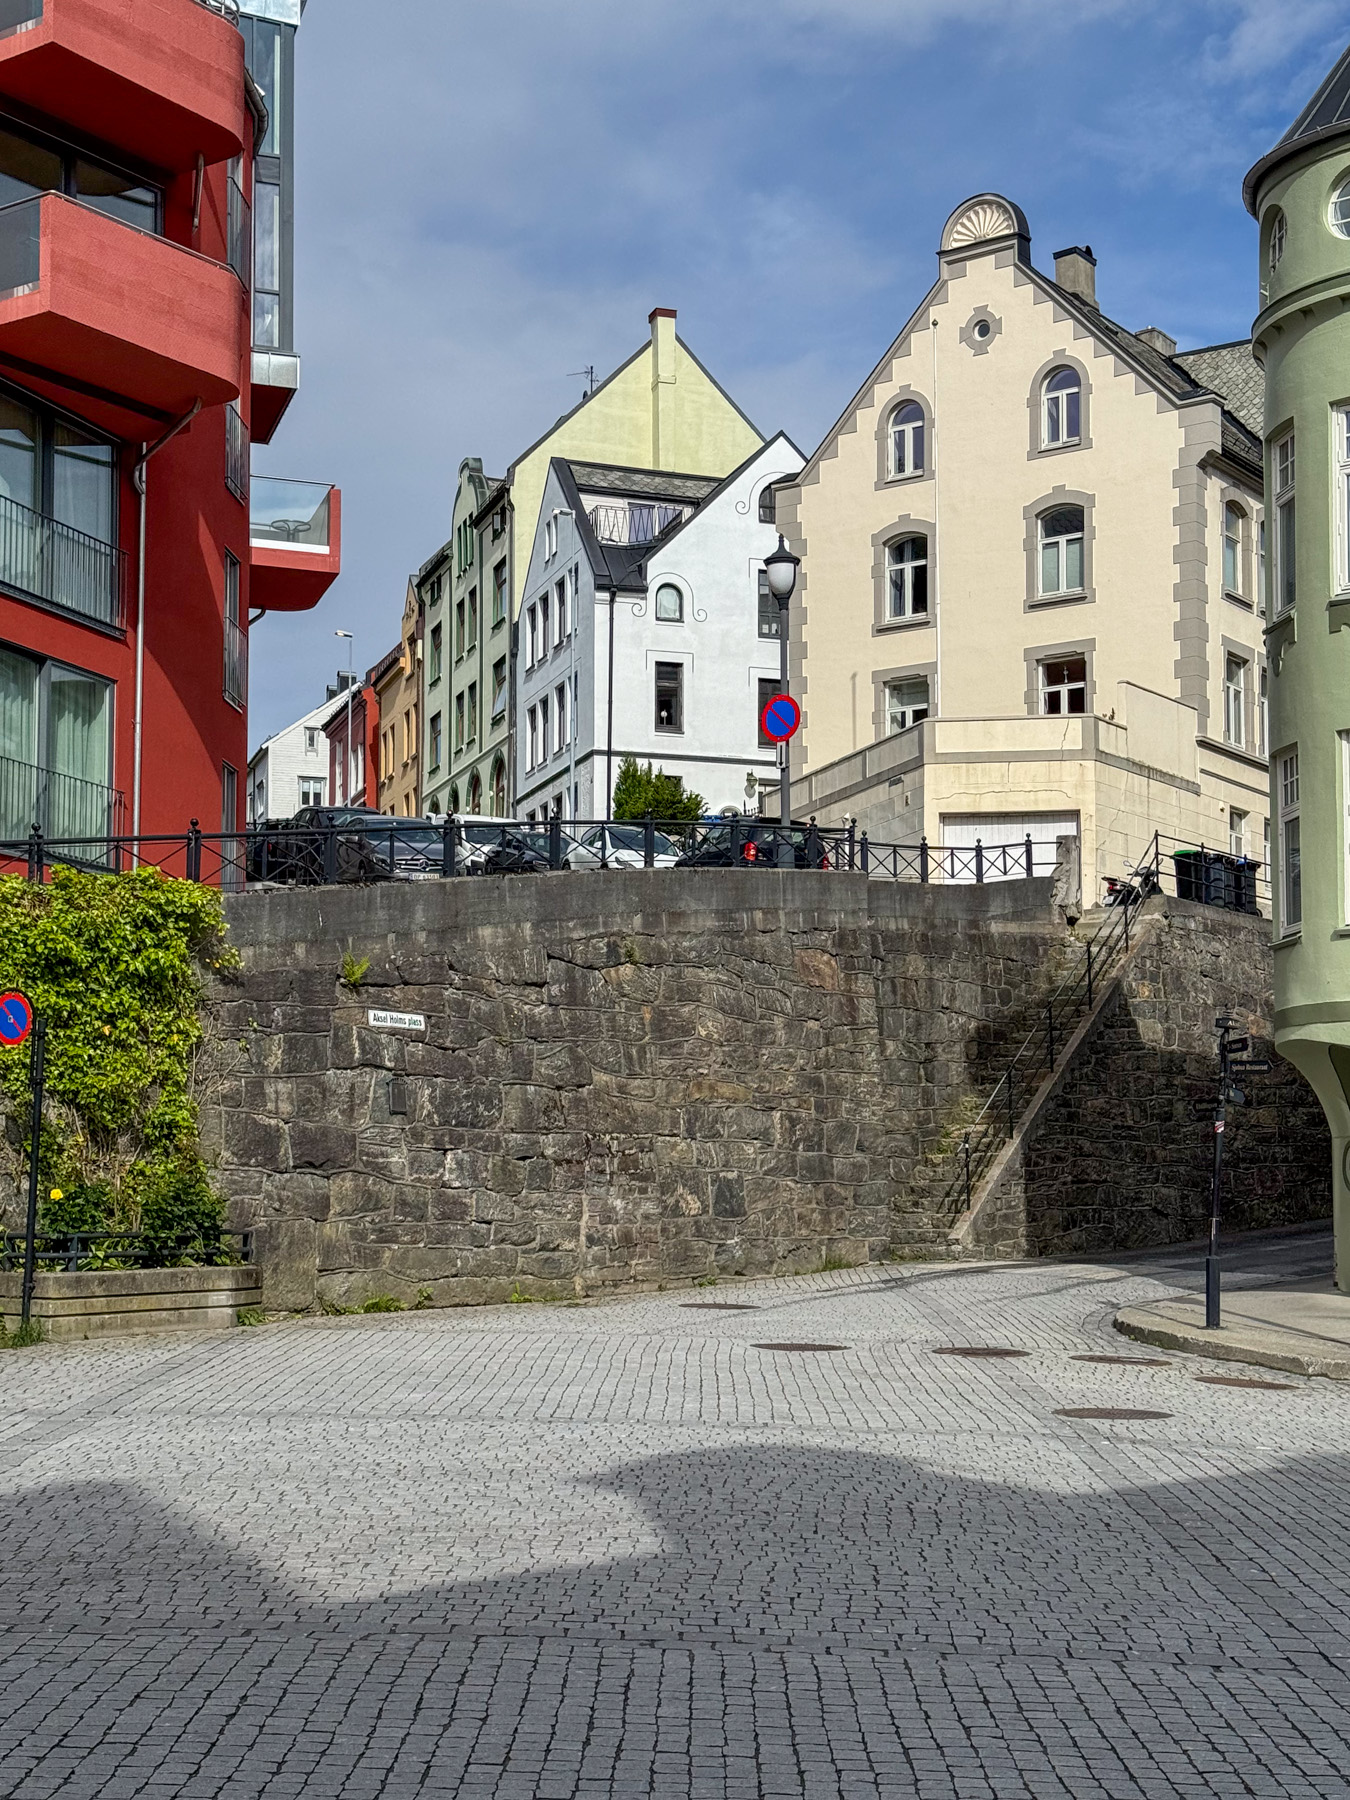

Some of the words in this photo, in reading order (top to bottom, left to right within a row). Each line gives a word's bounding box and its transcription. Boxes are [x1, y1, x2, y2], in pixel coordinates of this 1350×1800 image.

[373, 1012, 388, 1023] Aksel
[389, 1014, 406, 1025] Holms
[408, 1016, 422, 1027] plass
